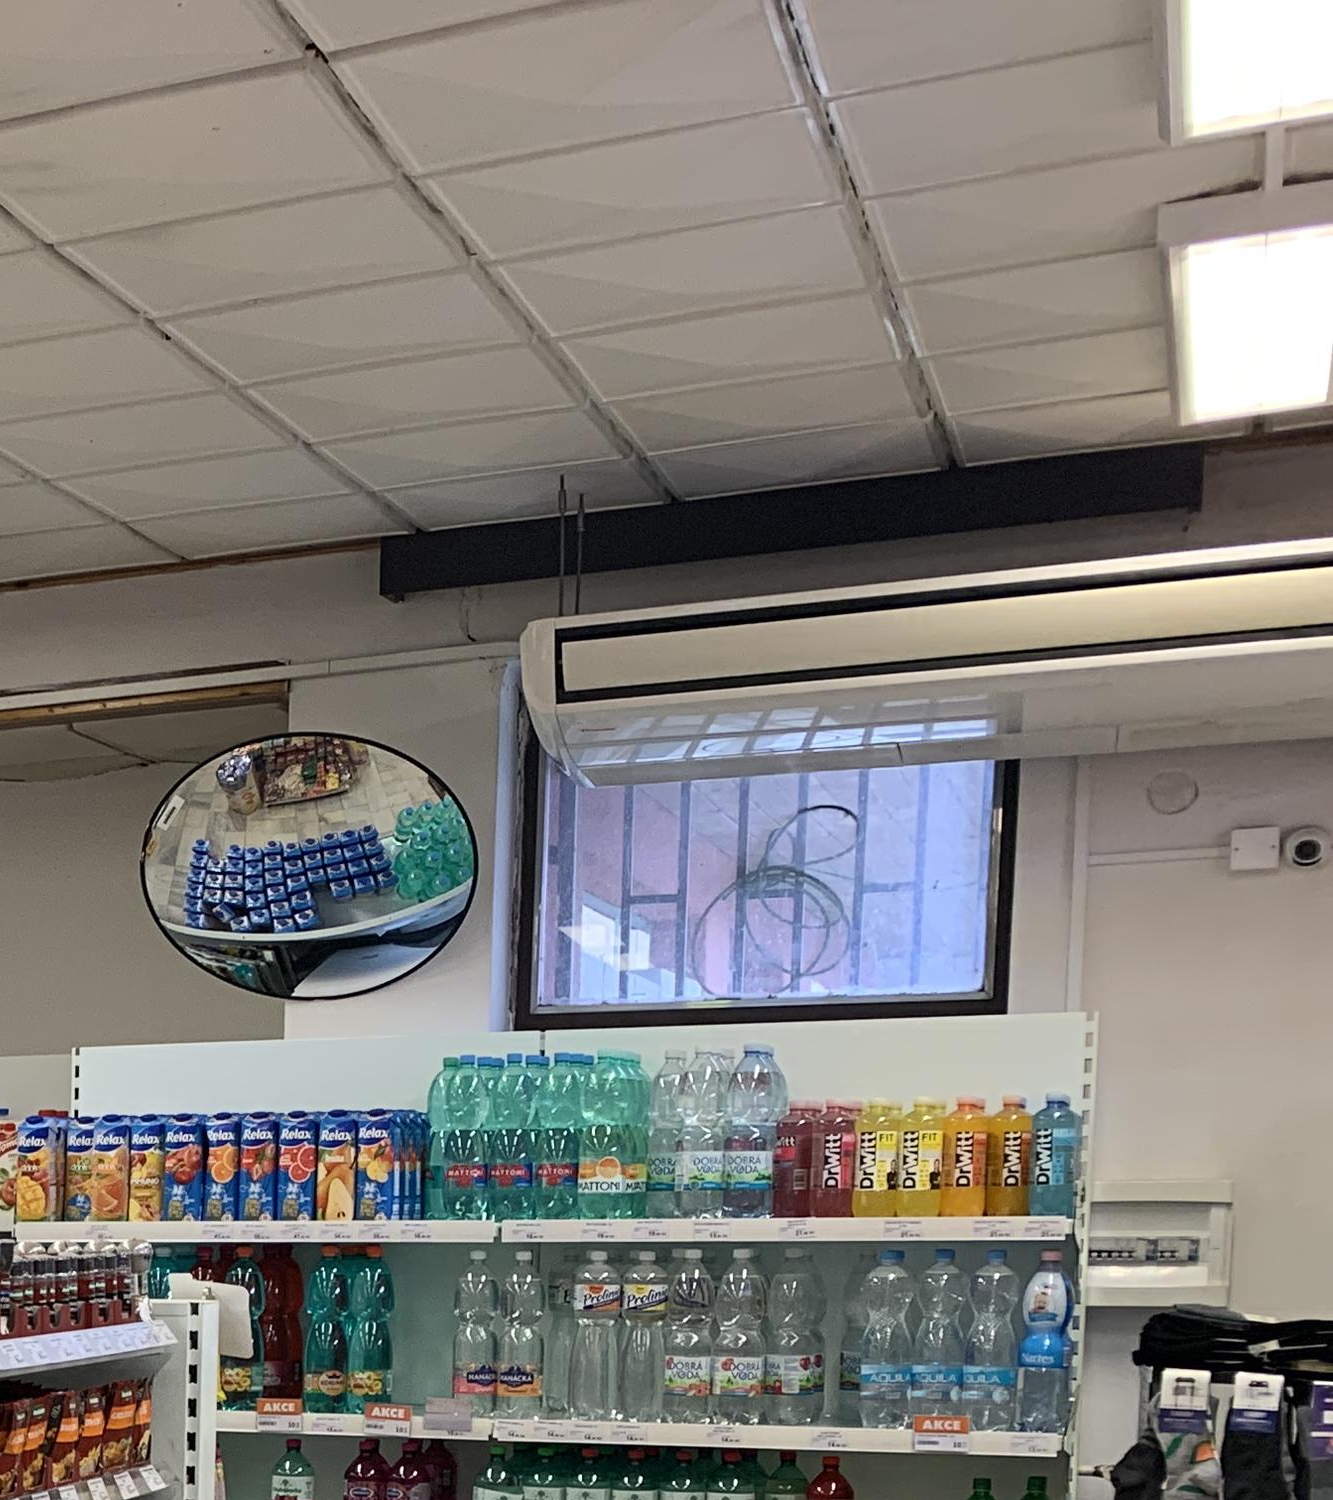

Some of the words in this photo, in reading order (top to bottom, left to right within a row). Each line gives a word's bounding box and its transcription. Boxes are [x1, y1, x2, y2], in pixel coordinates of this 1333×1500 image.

[96, 1133, 125, 1146] Relax
[132, 1133, 160, 1146] Relax
[166, 1130, 196, 1144] Relax
[243, 1128, 275, 1142] Relax
[281, 1127, 313, 1142] Relax
[320, 1128, 354, 1143] Relax
[358, 1126, 390, 1140] Relax
[879, 1131, 895, 1143] FIT
[921, 1131, 938, 1143] FIT
[19, 1135, 46, 1149] Relax
[728, 1152, 761, 1167] DOBRÁ
[824, 1131, 841, 1190] DrWitt
[859, 1131, 877, 1190] DrWitt
[902, 1131, 920, 1190] DrWitt
[955, 1131, 974, 1189] DrWitt
[1004, 1130, 1022, 1188] DrWitt
[1035, 1128, 1051, 1186] DrWitt
[733, 1164, 760, 1177] VODA
[578, 1180, 621, 1193] MATTONI
[913, 1372, 960, 1385] AQUILA
[263, 1402, 295, 1413] AKCE
[371, 1406, 405, 1417] AKCE
[923, 1419, 961, 1431] AKCE
